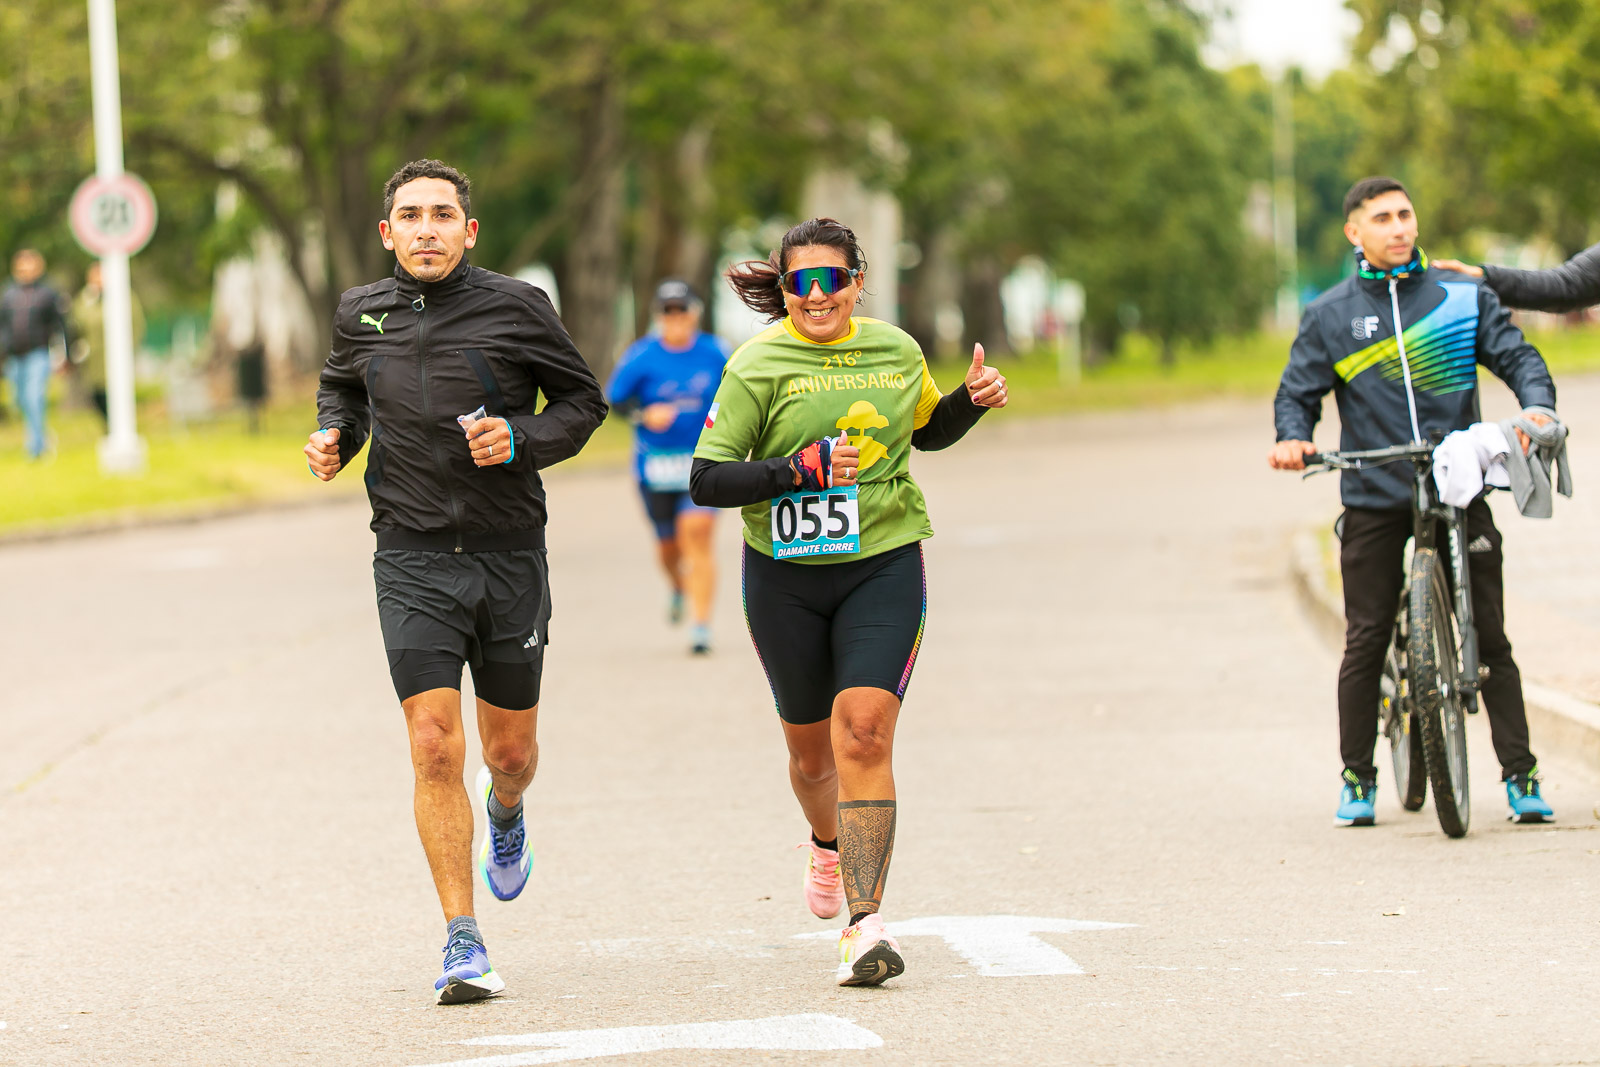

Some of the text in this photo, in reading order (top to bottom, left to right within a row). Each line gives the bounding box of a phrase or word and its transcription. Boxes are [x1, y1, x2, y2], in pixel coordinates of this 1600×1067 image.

[1351, 315, 1380, 340] SF
[787, 372, 907, 397] ANIVERSARIO
[776, 493, 850, 545] 055
[777, 542, 855, 557] DIAMANTE CORRE
